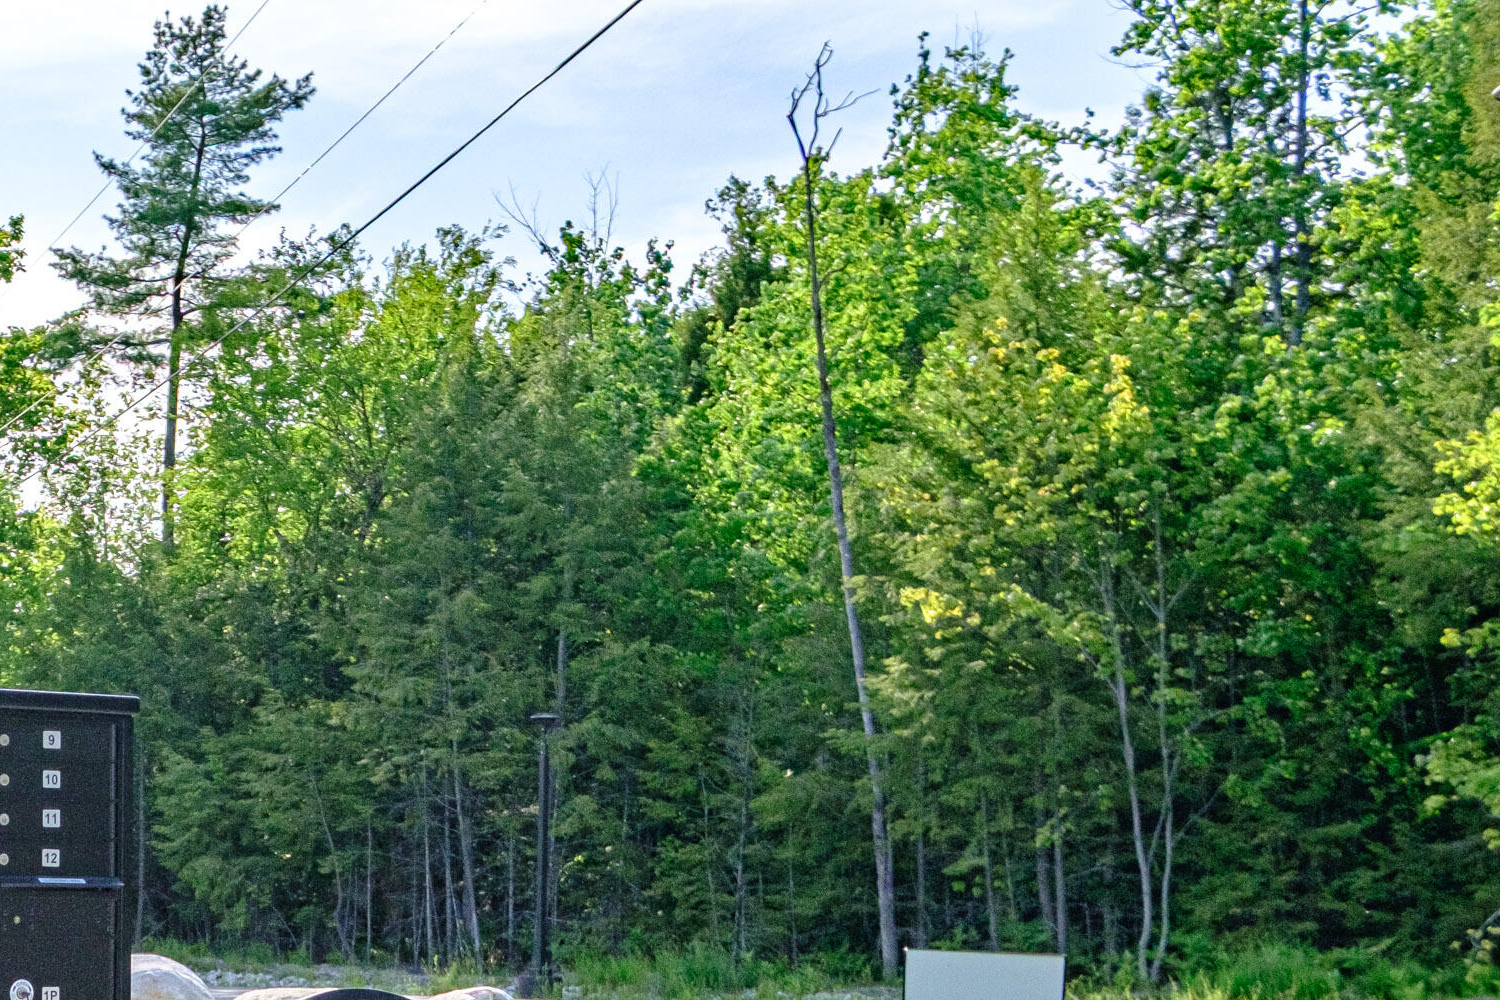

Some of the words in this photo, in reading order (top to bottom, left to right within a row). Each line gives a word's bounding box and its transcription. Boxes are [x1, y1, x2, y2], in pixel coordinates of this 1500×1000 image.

[48, 734, 55, 746] 9
[45, 773, 58, 785] 10
[44, 812, 57, 825] 11
[44, 852, 58, 864] 12
